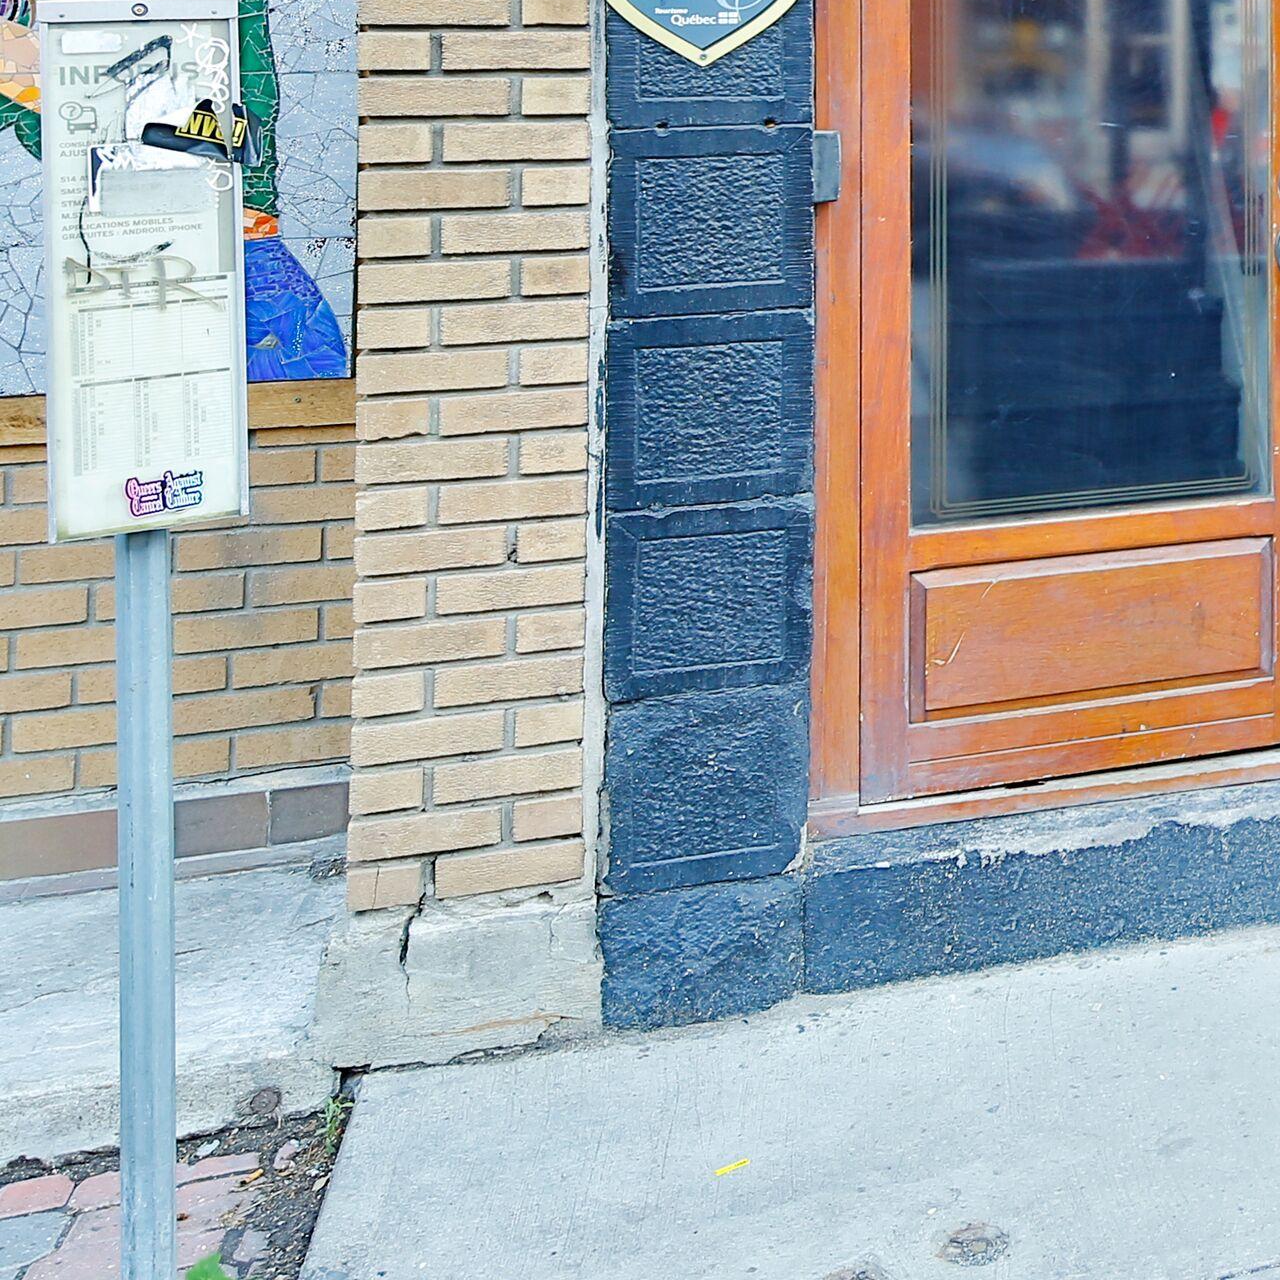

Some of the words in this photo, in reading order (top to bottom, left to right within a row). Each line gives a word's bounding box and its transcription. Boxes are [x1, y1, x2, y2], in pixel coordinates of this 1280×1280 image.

[670, 14, 718, 27] Québec
[132, 217, 174, 226] MOBILES
[126, 477, 162, 498] Queers
